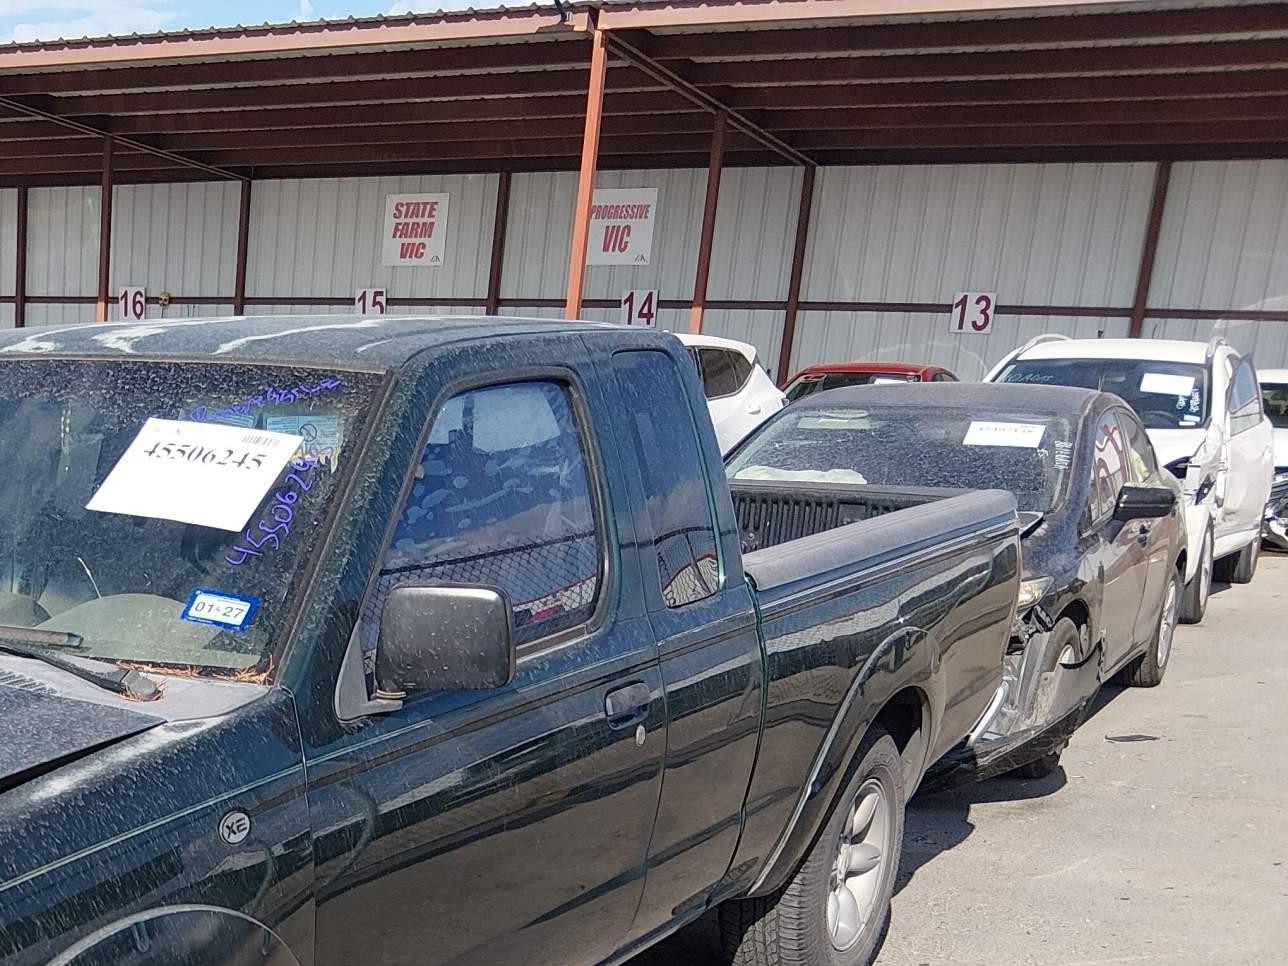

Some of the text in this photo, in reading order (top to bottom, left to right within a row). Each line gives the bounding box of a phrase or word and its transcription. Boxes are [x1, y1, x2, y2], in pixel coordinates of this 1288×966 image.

[393, 201, 439, 219] STATE
[590, 204, 651, 220] PROGRESSIVE
[392, 221, 435, 239] FARM
[602, 224, 632, 253] VIC
[399, 241, 427, 259] VIC
[120, 290, 145, 320] 16
[357, 290, 385, 315] 15
[623, 291, 655, 325] 14
[954, 294, 991, 331] 13
[143, 440, 268, 470] 45506245
[225, 817, 248, 839] XE
